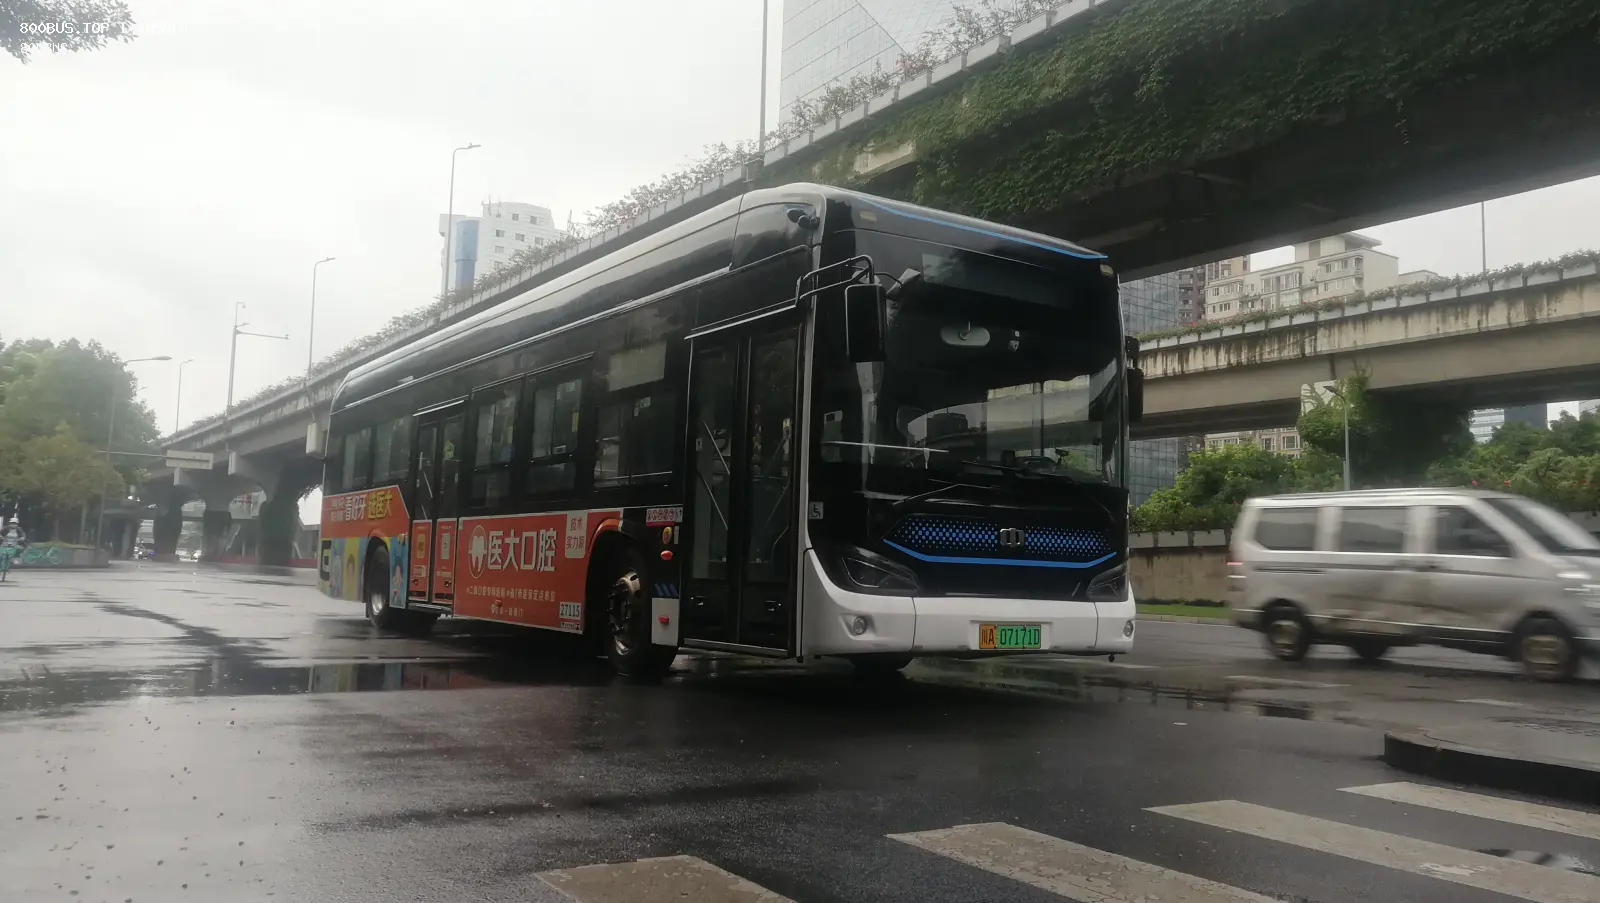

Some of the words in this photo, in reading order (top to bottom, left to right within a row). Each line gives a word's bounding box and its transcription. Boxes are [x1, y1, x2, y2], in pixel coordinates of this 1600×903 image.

[487, 527, 558, 573] 医大口腔
[560, 603, 580, 617] 27115
